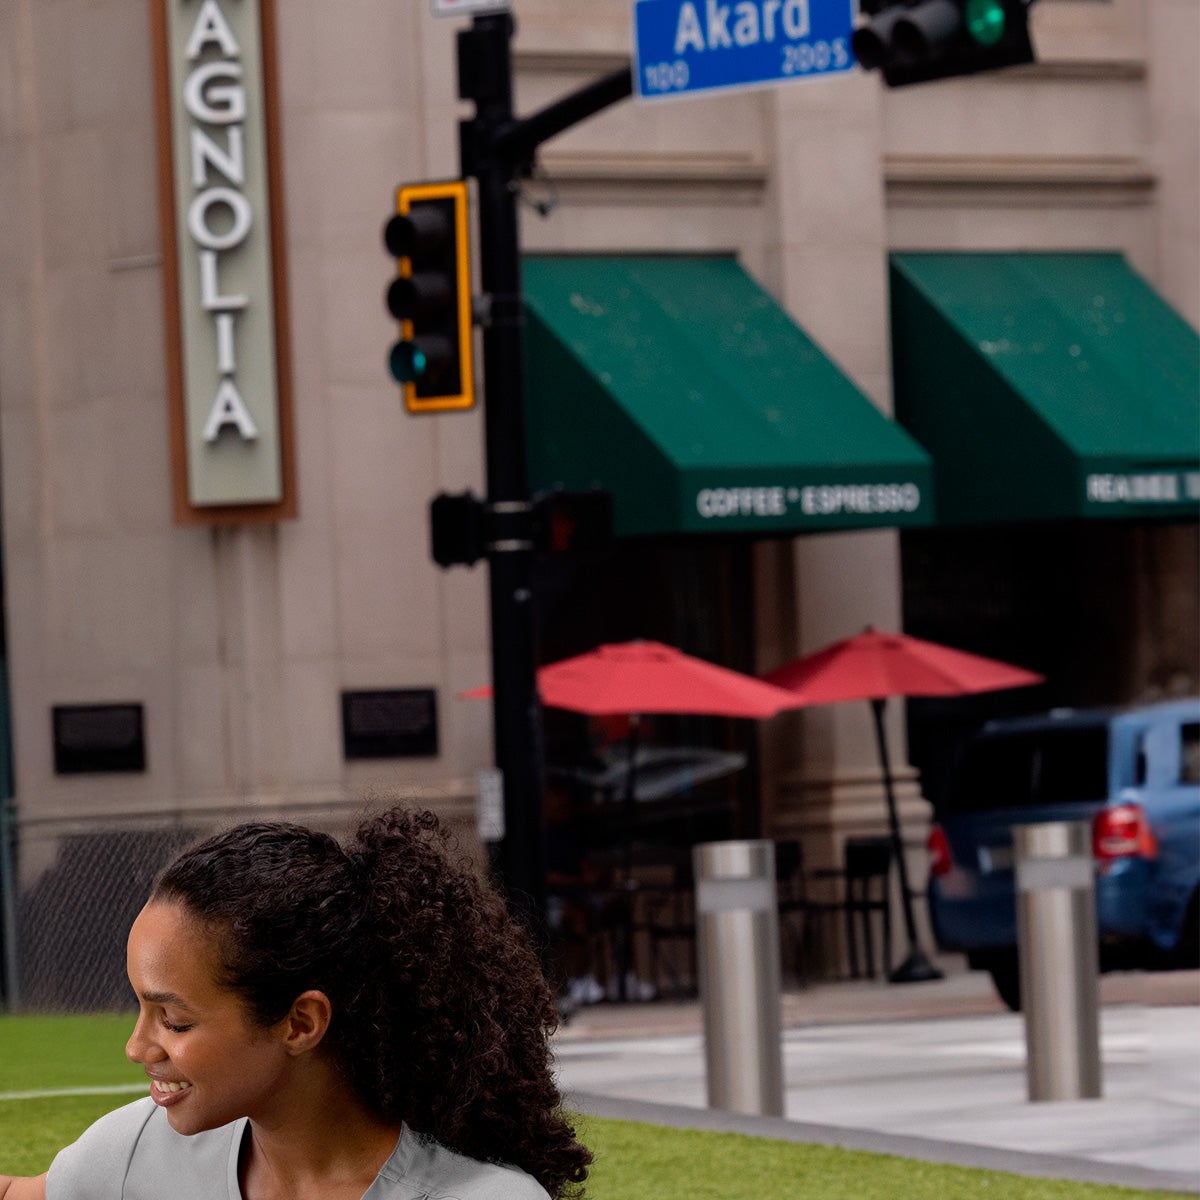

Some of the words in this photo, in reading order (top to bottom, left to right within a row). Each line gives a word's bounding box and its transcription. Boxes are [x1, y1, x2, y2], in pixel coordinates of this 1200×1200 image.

[675, 0, 810, 53] Akard
[697, 487, 787, 517] COFFEE
[802, 483, 920, 514] ESPRESSO
